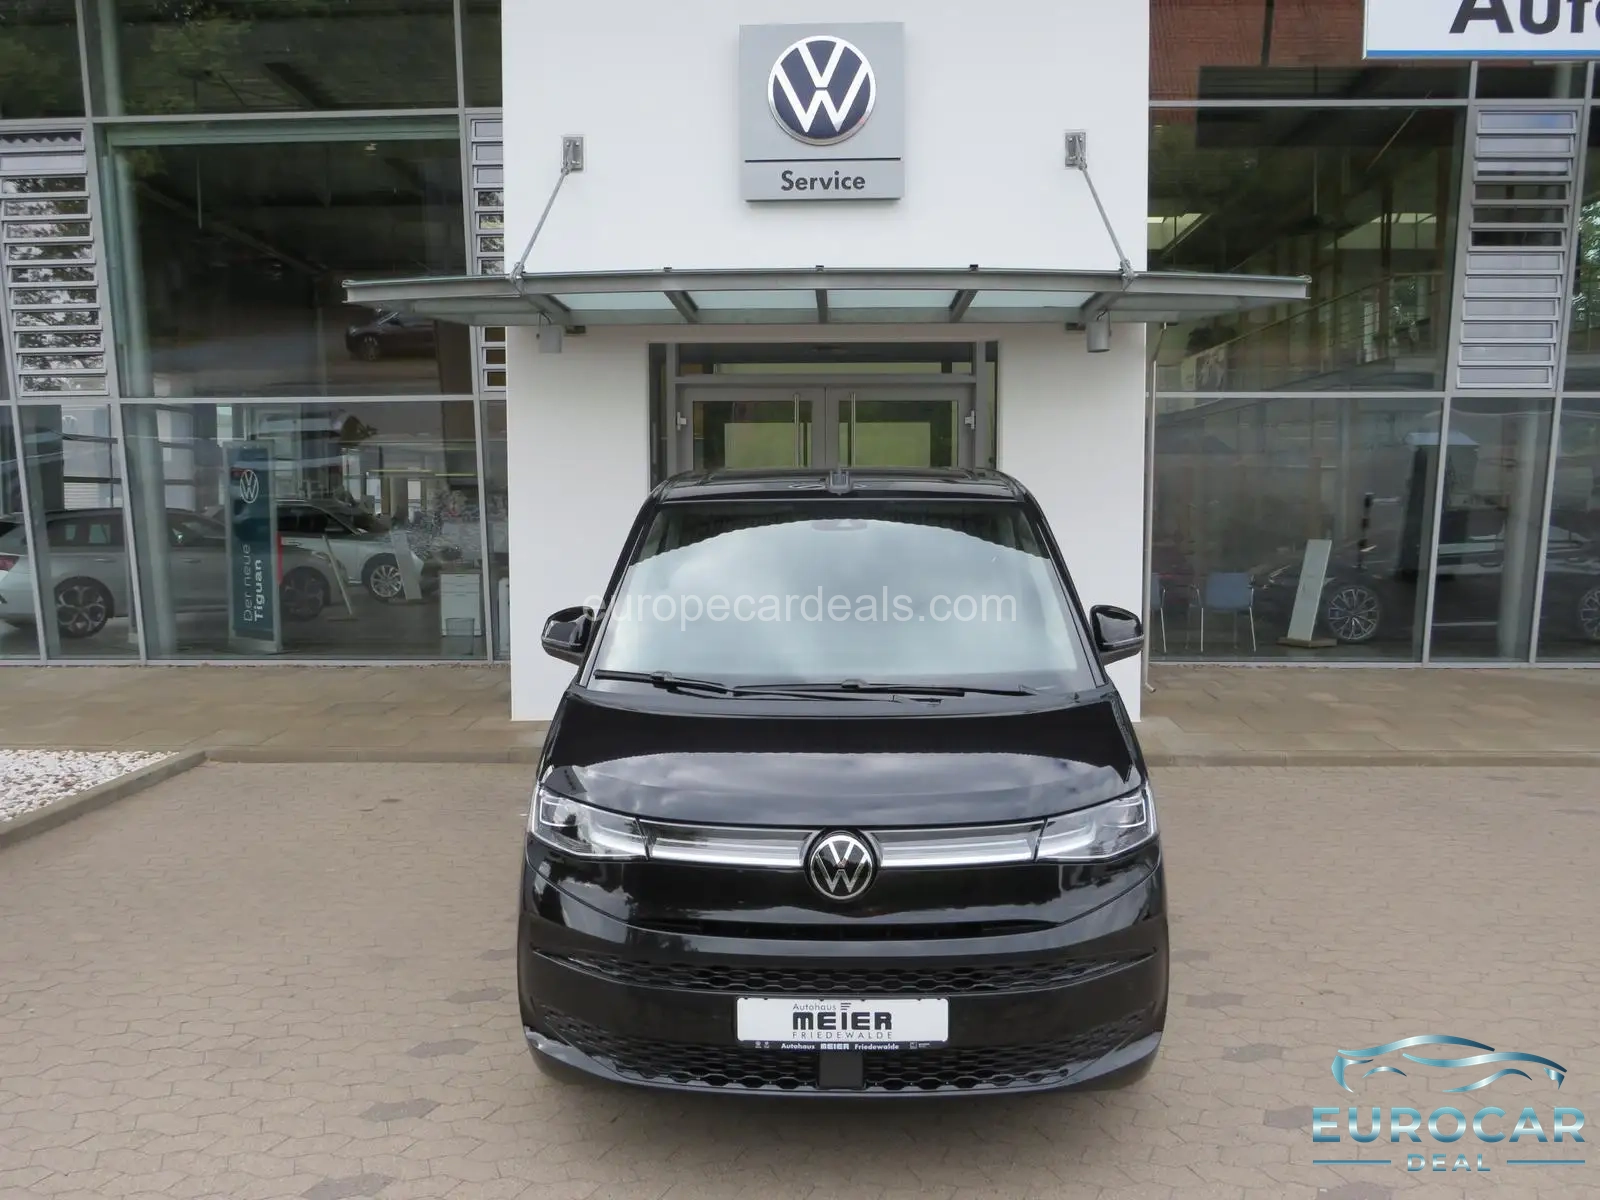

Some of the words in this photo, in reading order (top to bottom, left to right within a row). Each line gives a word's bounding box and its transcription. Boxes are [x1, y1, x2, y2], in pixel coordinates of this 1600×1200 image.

[1449, 0, 1600, 35] Aut
[781, 169, 866, 191] Service
[242, 543, 252, 587] neue
[254, 559, 265, 621] Tiguan
[243, 591, 253, 622] Der
[792, 1002, 837, 1011] Autohaus
[792, 1011, 892, 1031] MEIER
[792, 1031, 892, 1040] FRIEDEWALDE
